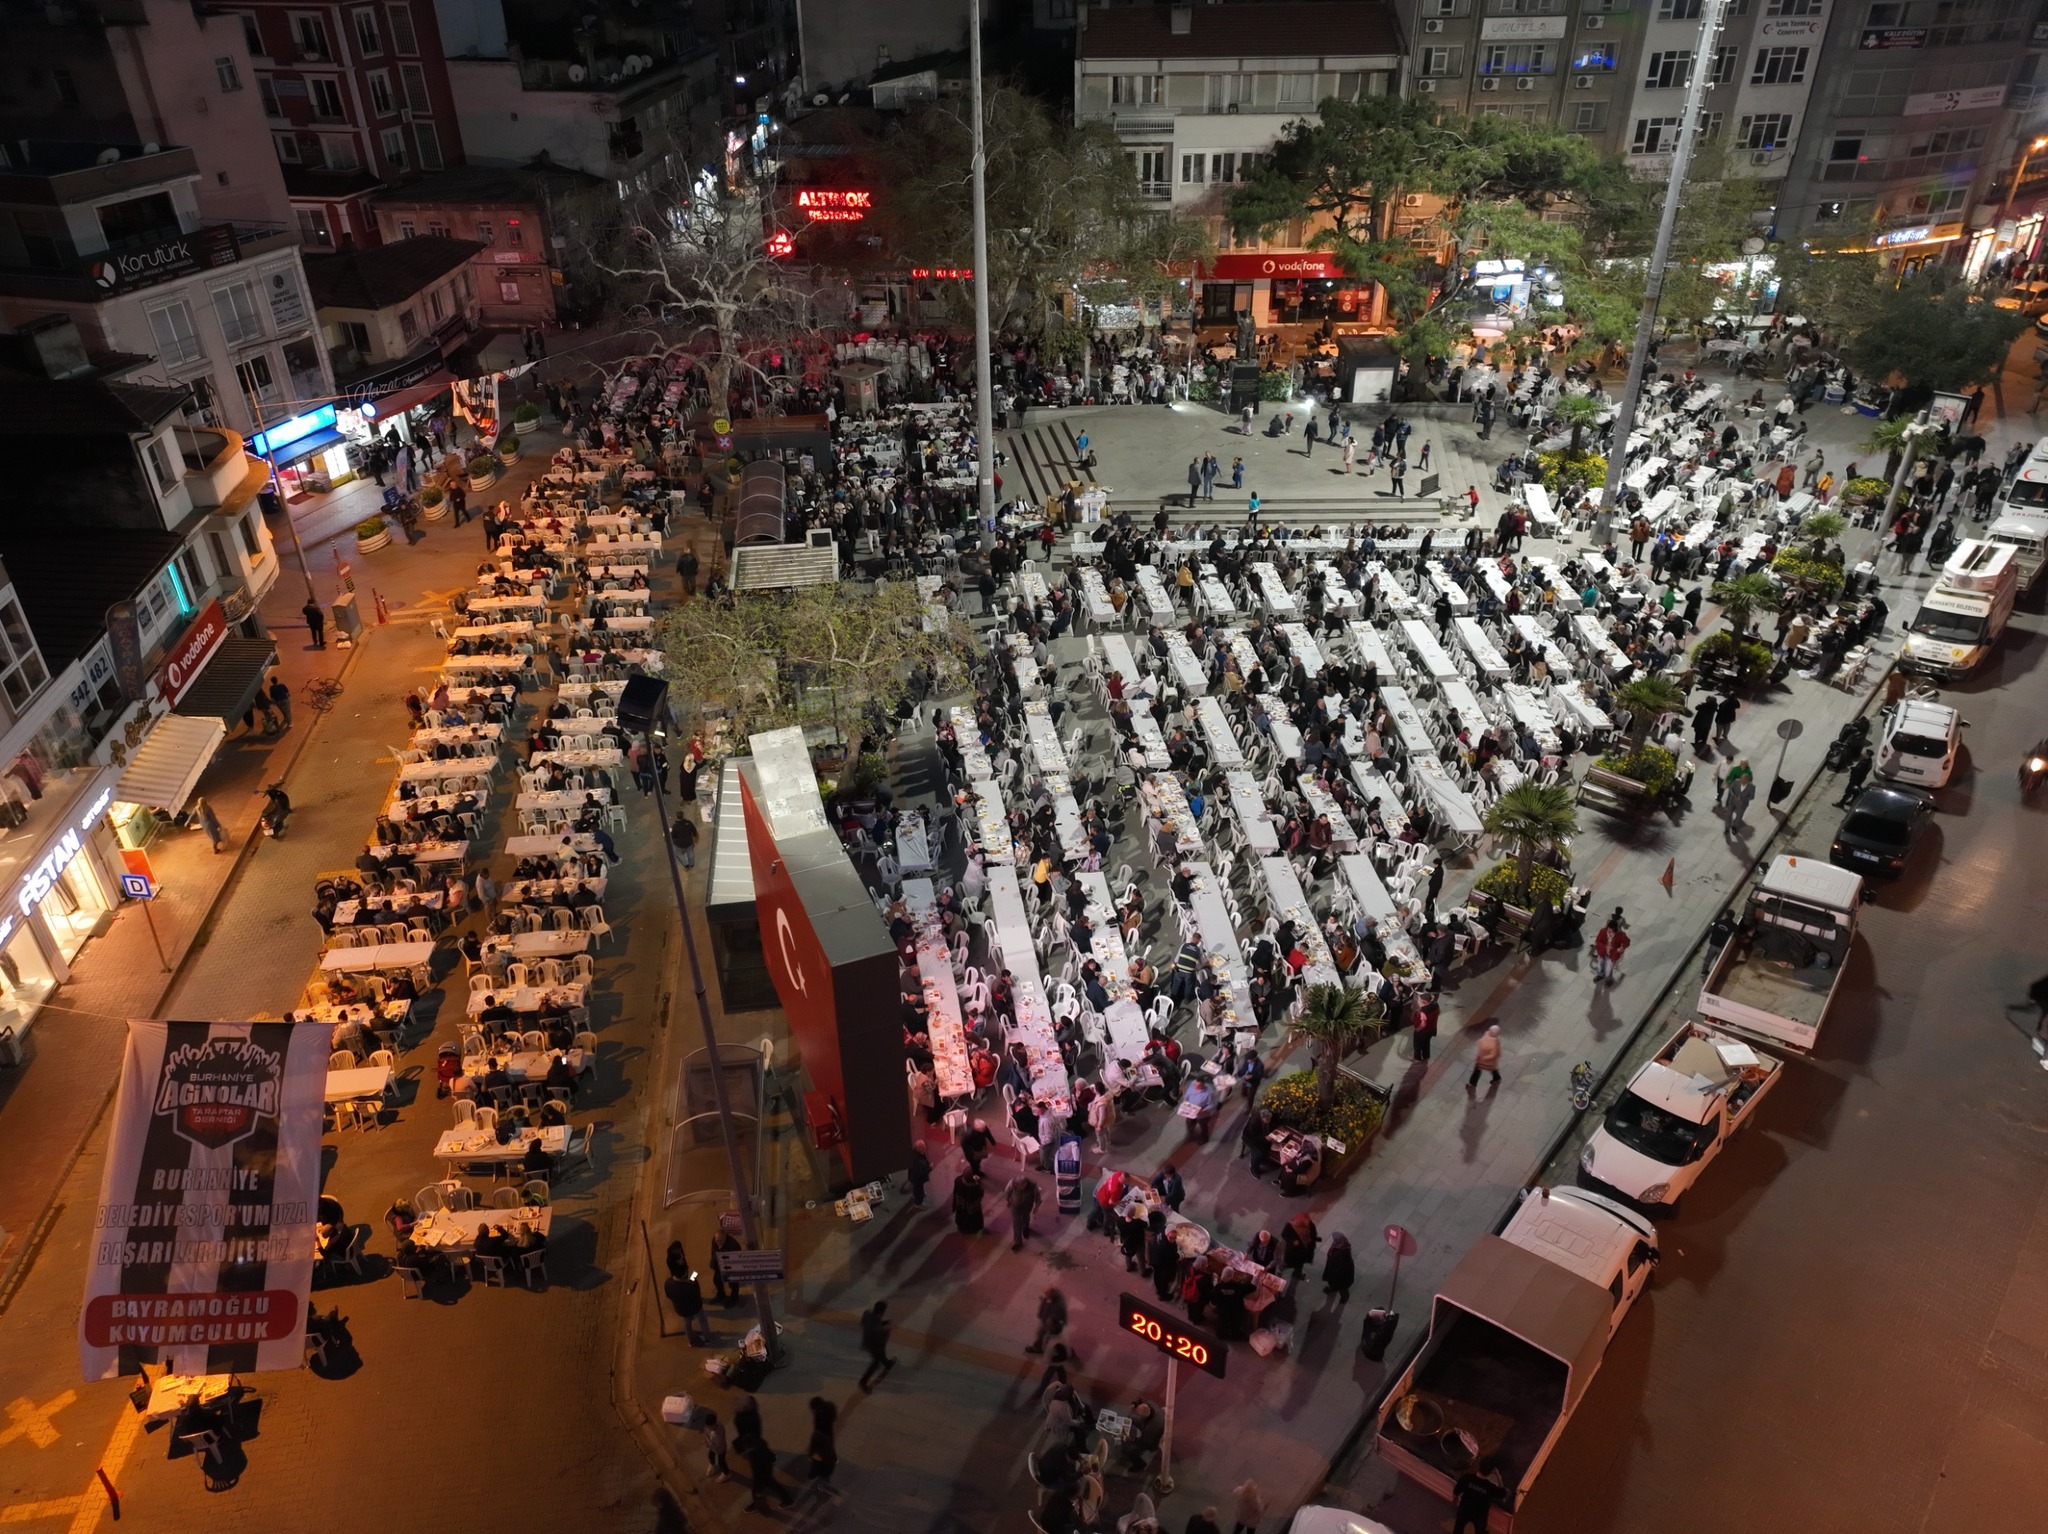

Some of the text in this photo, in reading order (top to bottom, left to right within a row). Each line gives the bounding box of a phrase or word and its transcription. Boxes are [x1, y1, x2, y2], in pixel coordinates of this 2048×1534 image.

[117, 241, 191, 275] Korutürk
[1279, 261, 1325, 271] vodafone
[180, 622, 215, 670] vodafone
[71, 680, 90, 707] 542
[18, 827, 81, 917] FİSTAN
[130, 880, 143, 893] D
[189, 1072, 254, 1082] BURHANİYE
[192, 1108, 241, 1116] TARAFTAR
[194, 1116, 237, 1124] DERNEĞİ
[152, 1166, 259, 1191] BURHANİYE
[96, 1201, 308, 1228] BELEDİYESPOR'UMUZA
[97, 1237, 295, 1268] BAŞARILAR DİLERİZ.
[111, 1295, 270, 1318] BAYRAMOĞLU
[109, 1321, 269, 1344] KUYUMCULUK
[1131, 1312, 1208, 1365] 20:20
